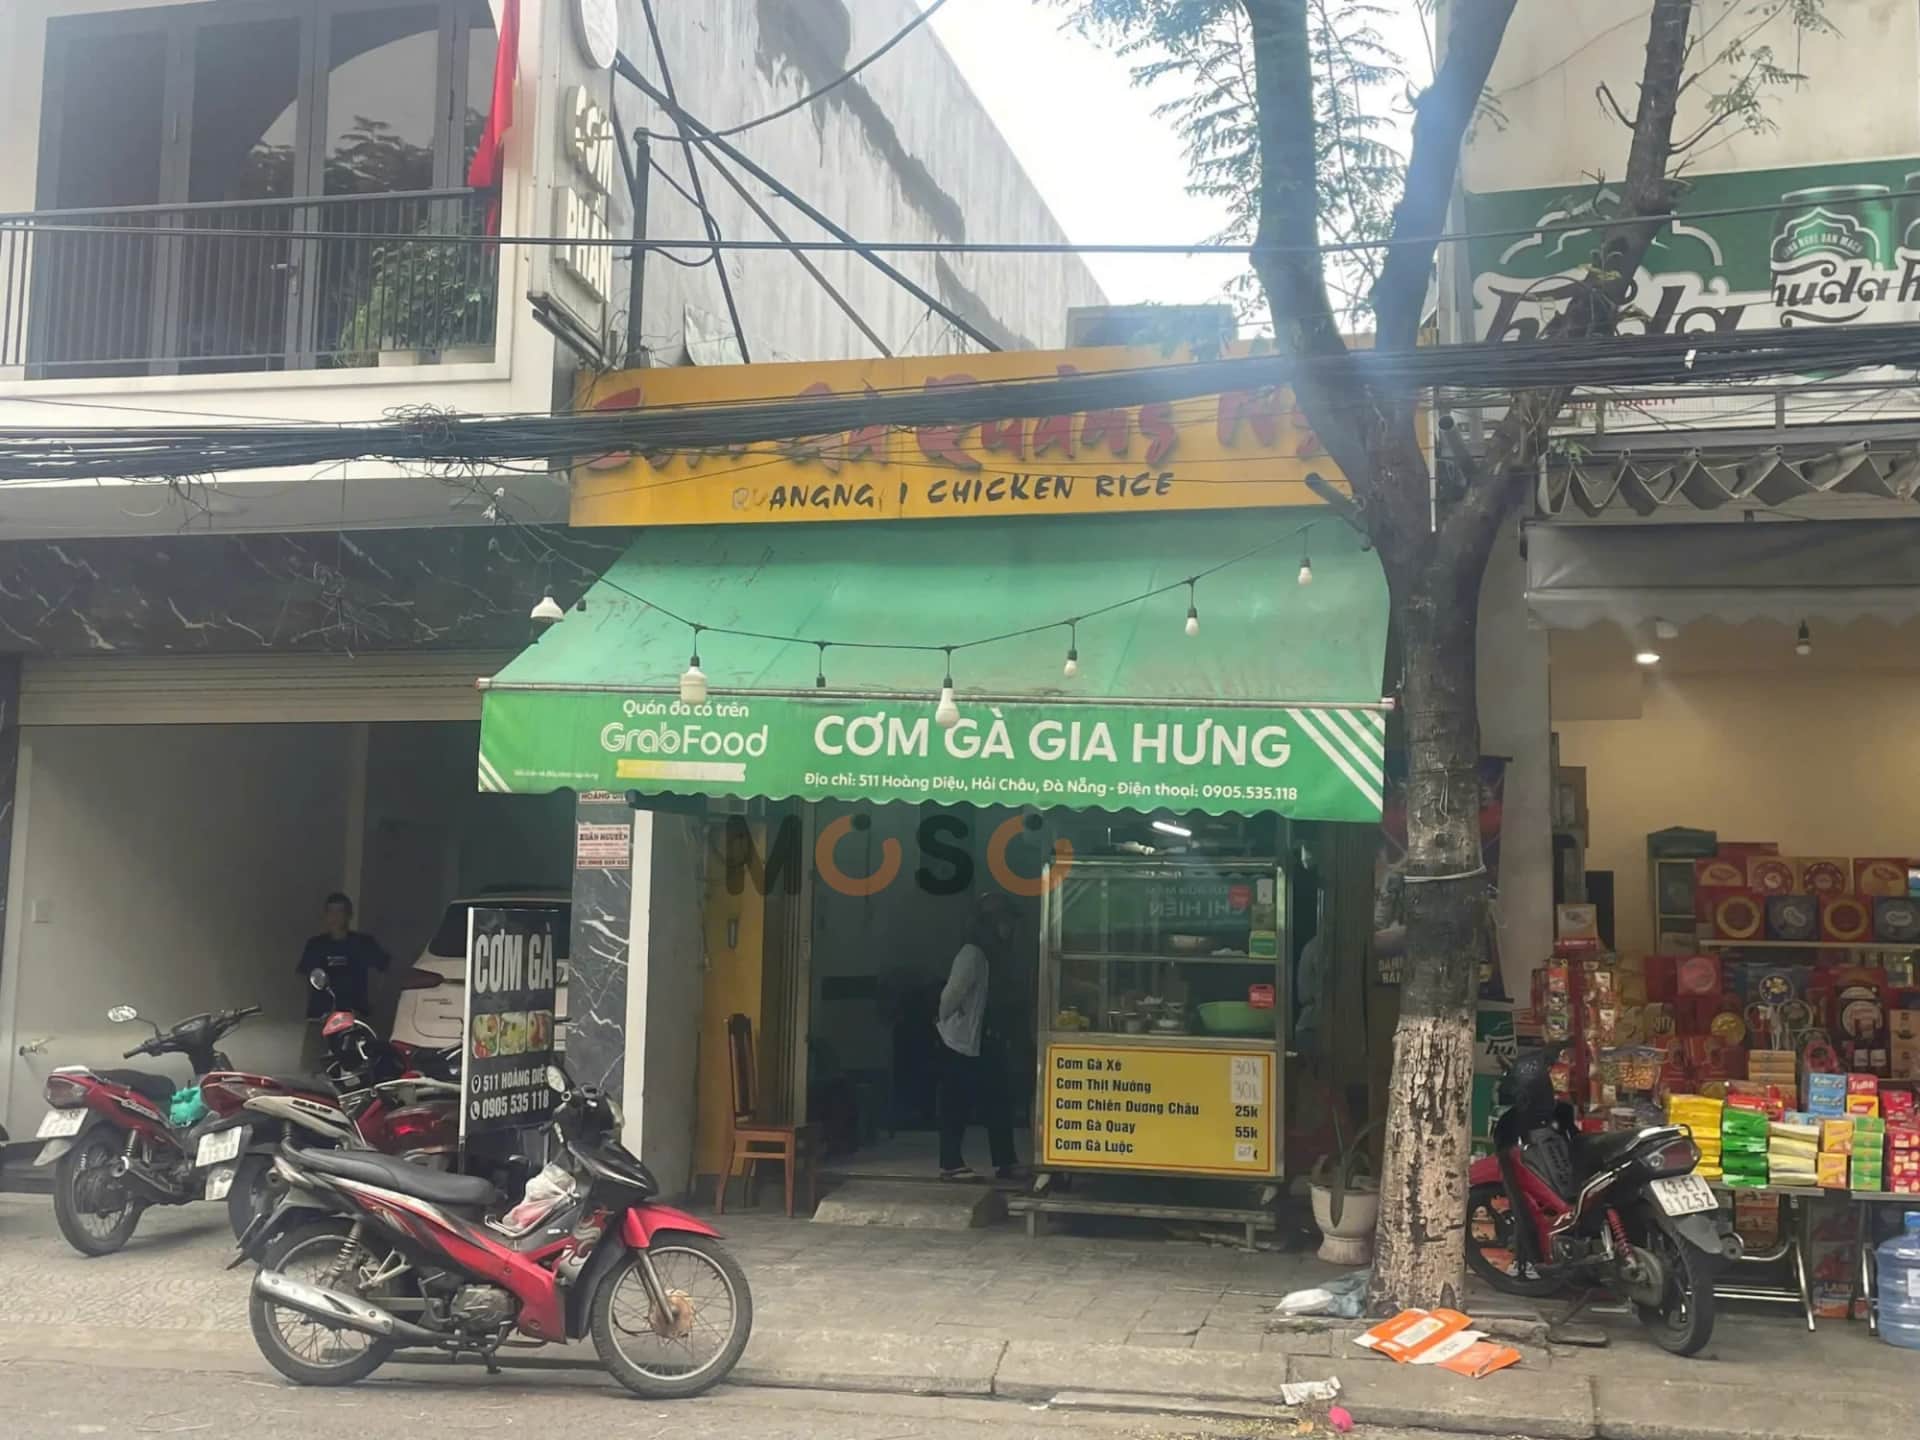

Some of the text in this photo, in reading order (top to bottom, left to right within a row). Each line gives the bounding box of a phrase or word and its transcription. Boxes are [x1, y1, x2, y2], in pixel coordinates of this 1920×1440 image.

[1771, 260, 1891, 308] huda
[927, 474, 1074, 505] CHICKEN
[1096, 472, 1175, 497] RICE
[623, 699, 667, 718] Quán
[693, 701, 713, 717] có
[716, 701, 750, 718] trên
[600, 721, 769, 758] GrabFood
[814, 707, 1292, 769] CƠM GÀ GIA HƯNG
[804, 772, 829, 788] Địa
[831, 770, 857, 787] chỉ:
[859, 774, 880, 787] 511
[882, 774, 929, 792] Hoàng
[932, 776, 969, 792] Diệu,
[971, 776, 996, 791] Hải
[999, 777, 1040, 795] Châu,
[1043, 778, 1064, 793] Đà
[1067, 776, 1107, 798] Nẵng
[1117, 781, 1152, 798] Điện
[1154, 782, 1199, 800] thoại:
[1202, 784, 1298, 801] 0905.535.118
[473, 922, 554, 994] CƠM GÀ
[1087, 1057, 1103, 1071] Gà
[483, 1073, 499, 1092] 511
[500, 1069, 531, 1090] HOÀNG
[481, 1089, 550, 1120] 0905 535 118
[1234, 1104, 1258, 1119] 25k
[1086, 1118, 1102, 1132] Gà
[1105, 1119, 1136, 1135] Quay
[1234, 1125, 1258, 1139] 55k
[1086, 1138, 1101, 1153] Gà
